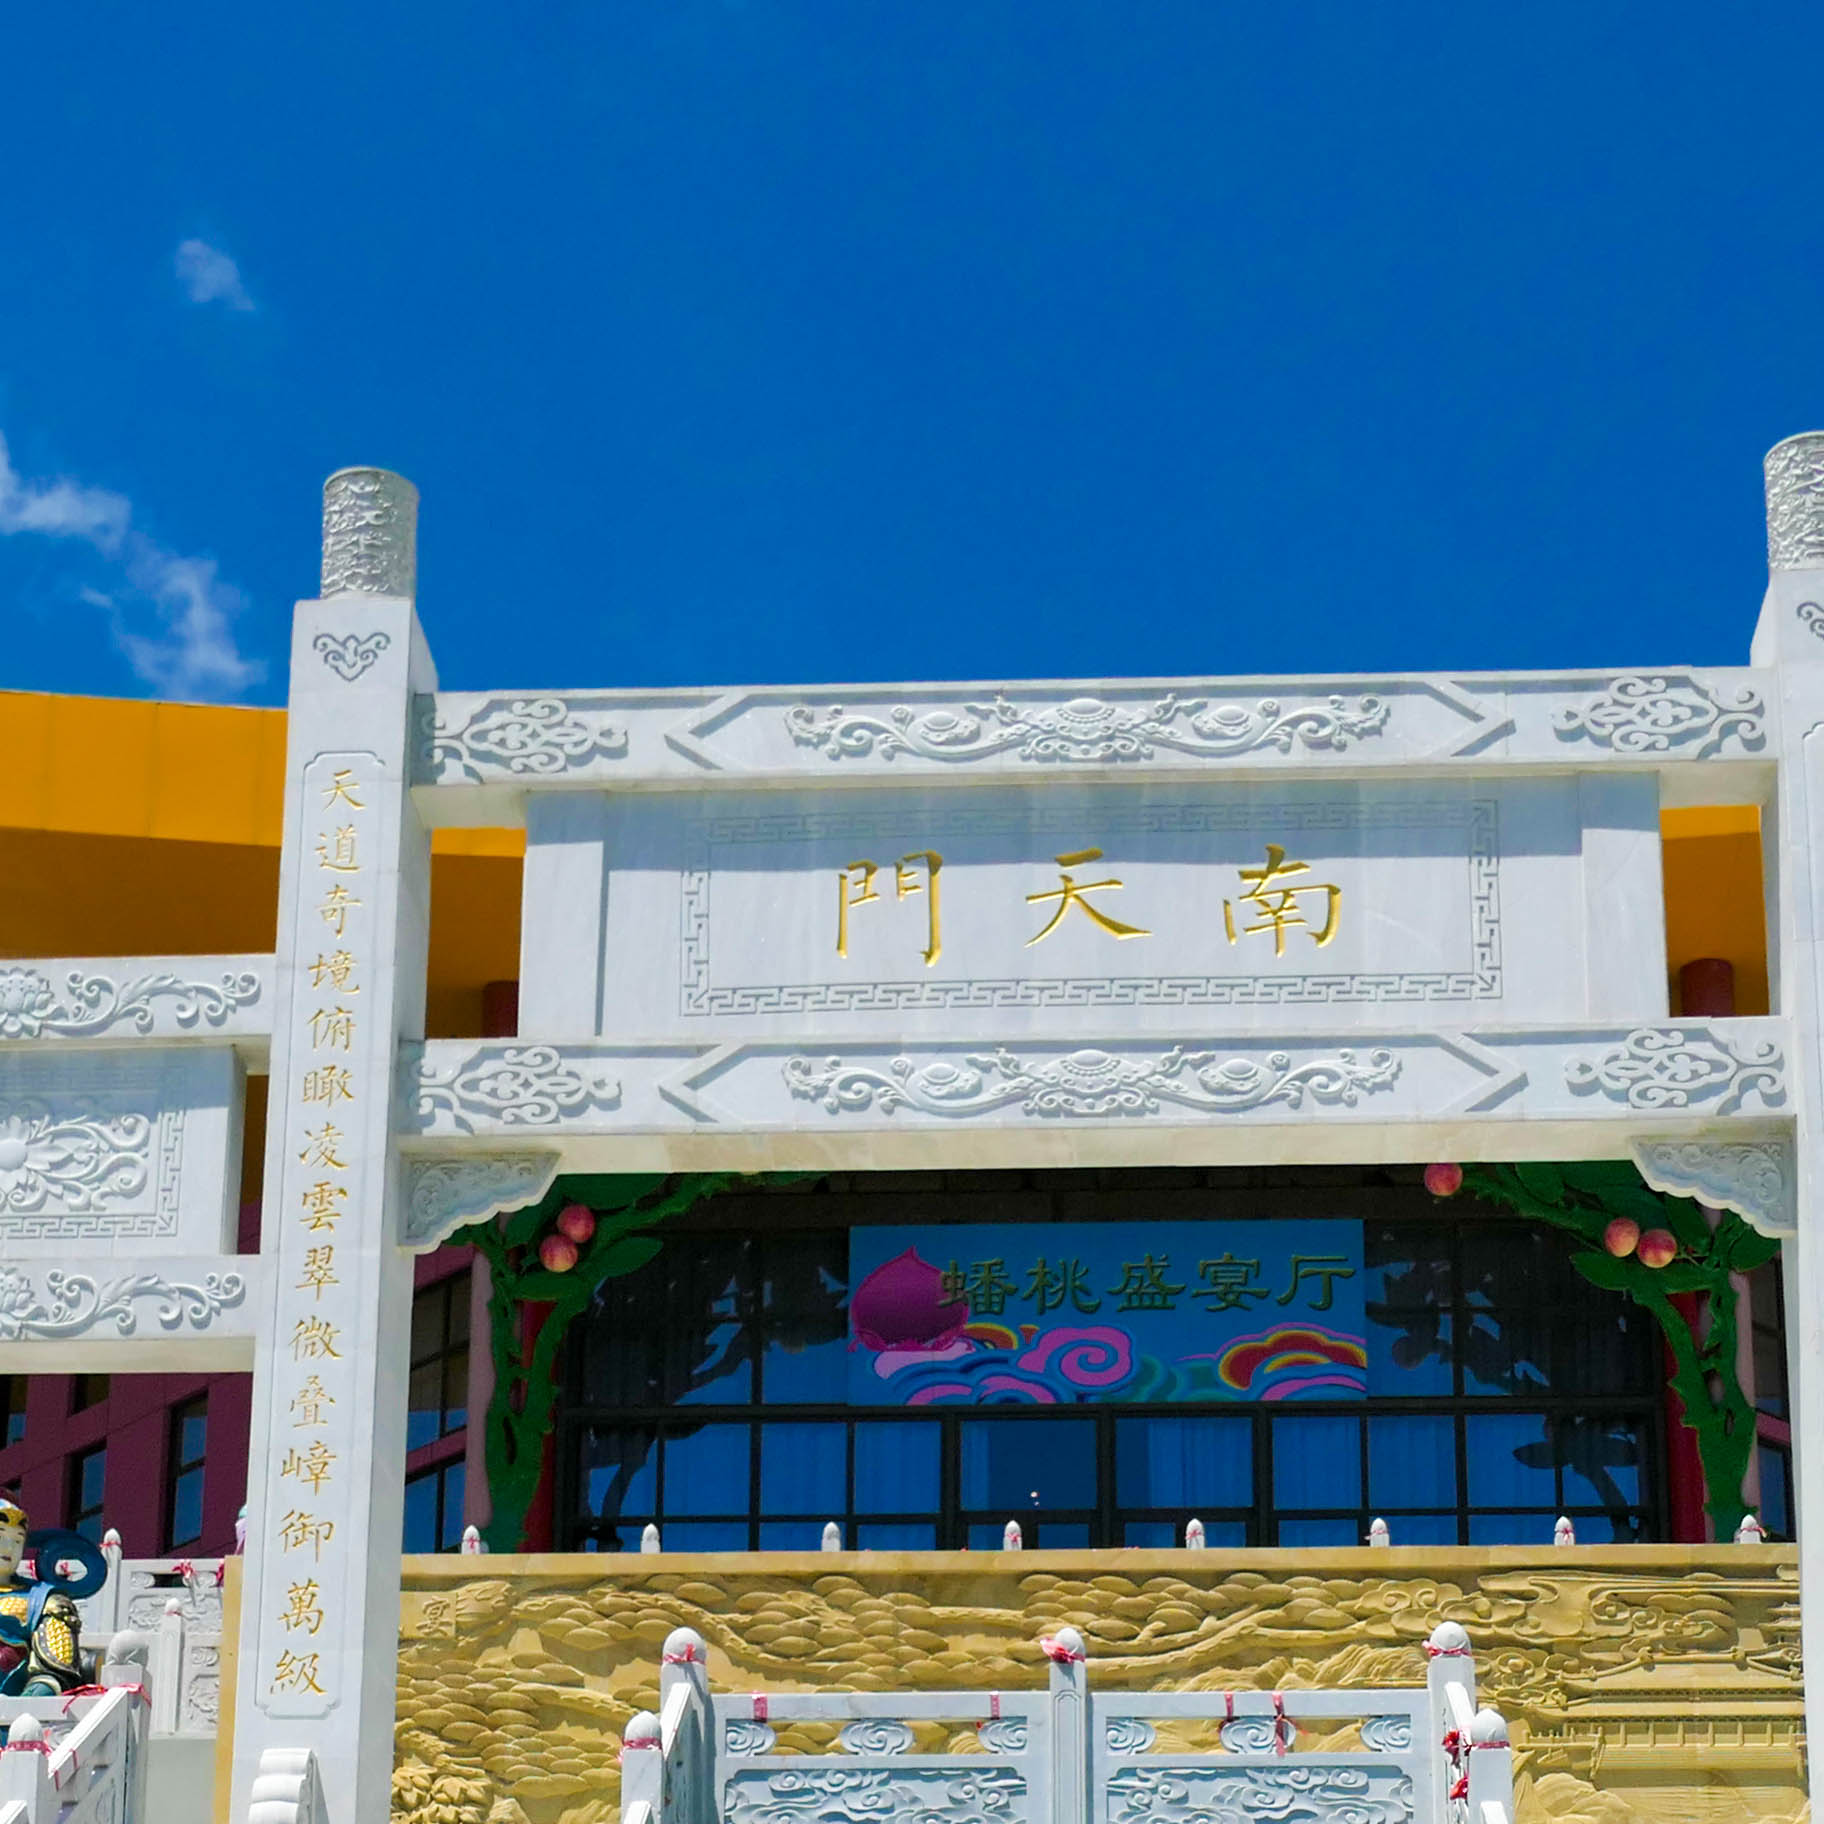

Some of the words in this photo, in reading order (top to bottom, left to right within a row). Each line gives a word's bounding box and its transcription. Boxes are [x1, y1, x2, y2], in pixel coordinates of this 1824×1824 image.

[936, 1252, 1356, 1316] 蟠桃盛宴厅
